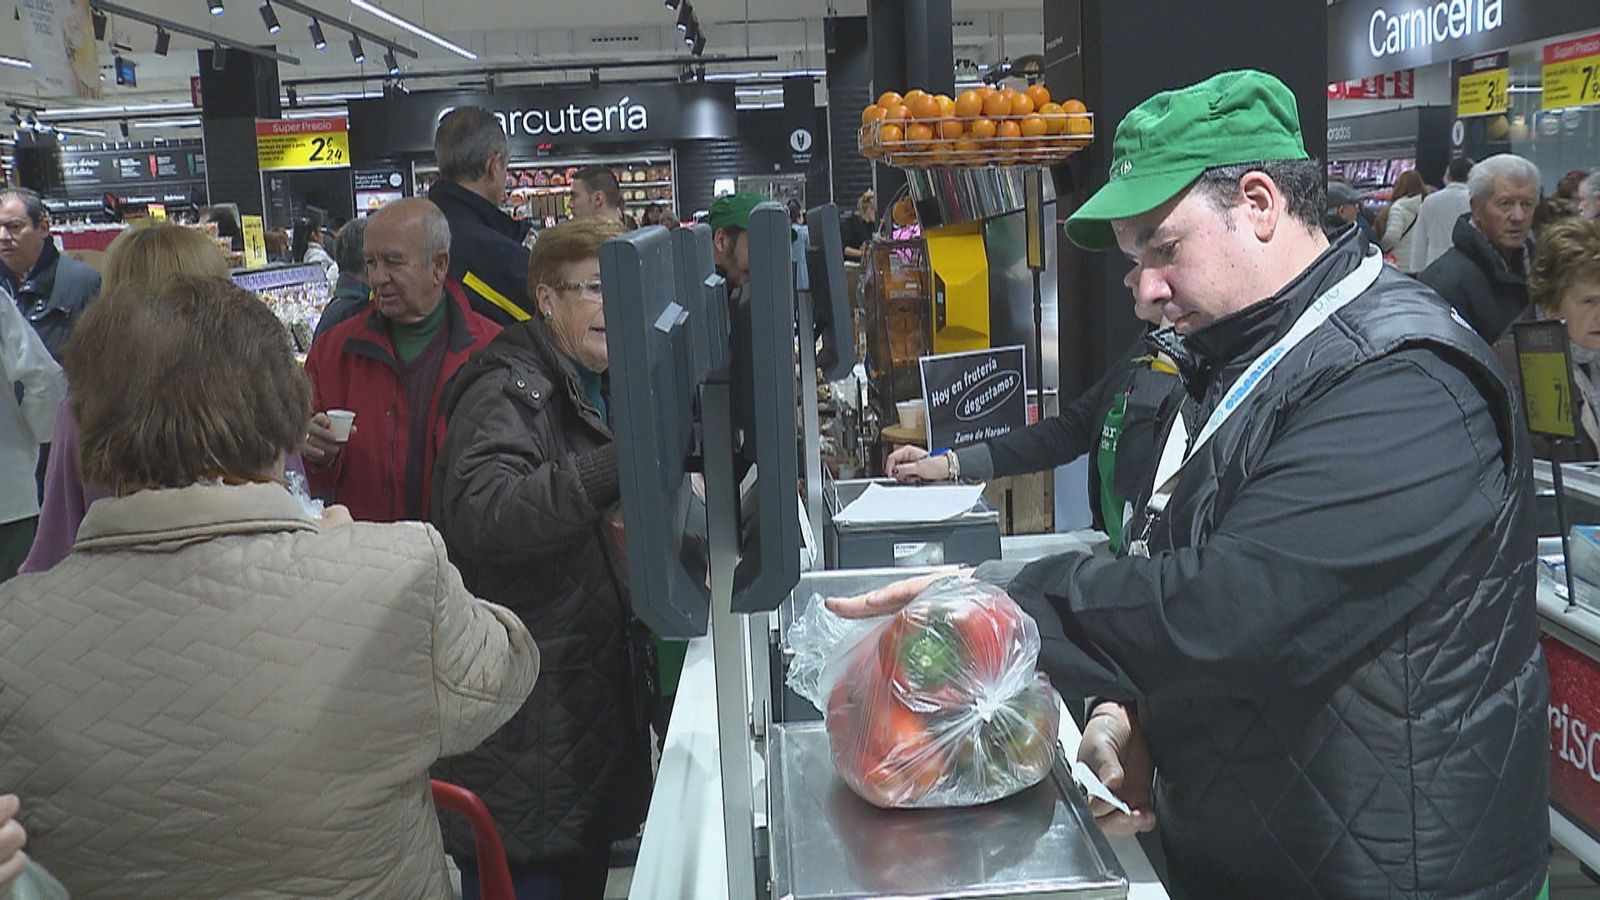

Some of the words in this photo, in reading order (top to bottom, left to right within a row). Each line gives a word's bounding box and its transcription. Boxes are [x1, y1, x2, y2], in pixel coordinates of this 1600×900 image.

[1486, 81, 1495, 111] 3
[1580, 66, 1593, 101] 7
[272, 122, 300, 134] Super
[301, 120, 332, 132] Precio
[438, 97, 648, 136] arcutería
[931, 388, 950, 408] Hoy
[951, 379, 963, 395] en
[963, 356, 998, 387] frutería
[964, 374, 1014, 416] degustamos
[955, 432, 974, 444] Zumo
[975, 428, 984, 440] de
